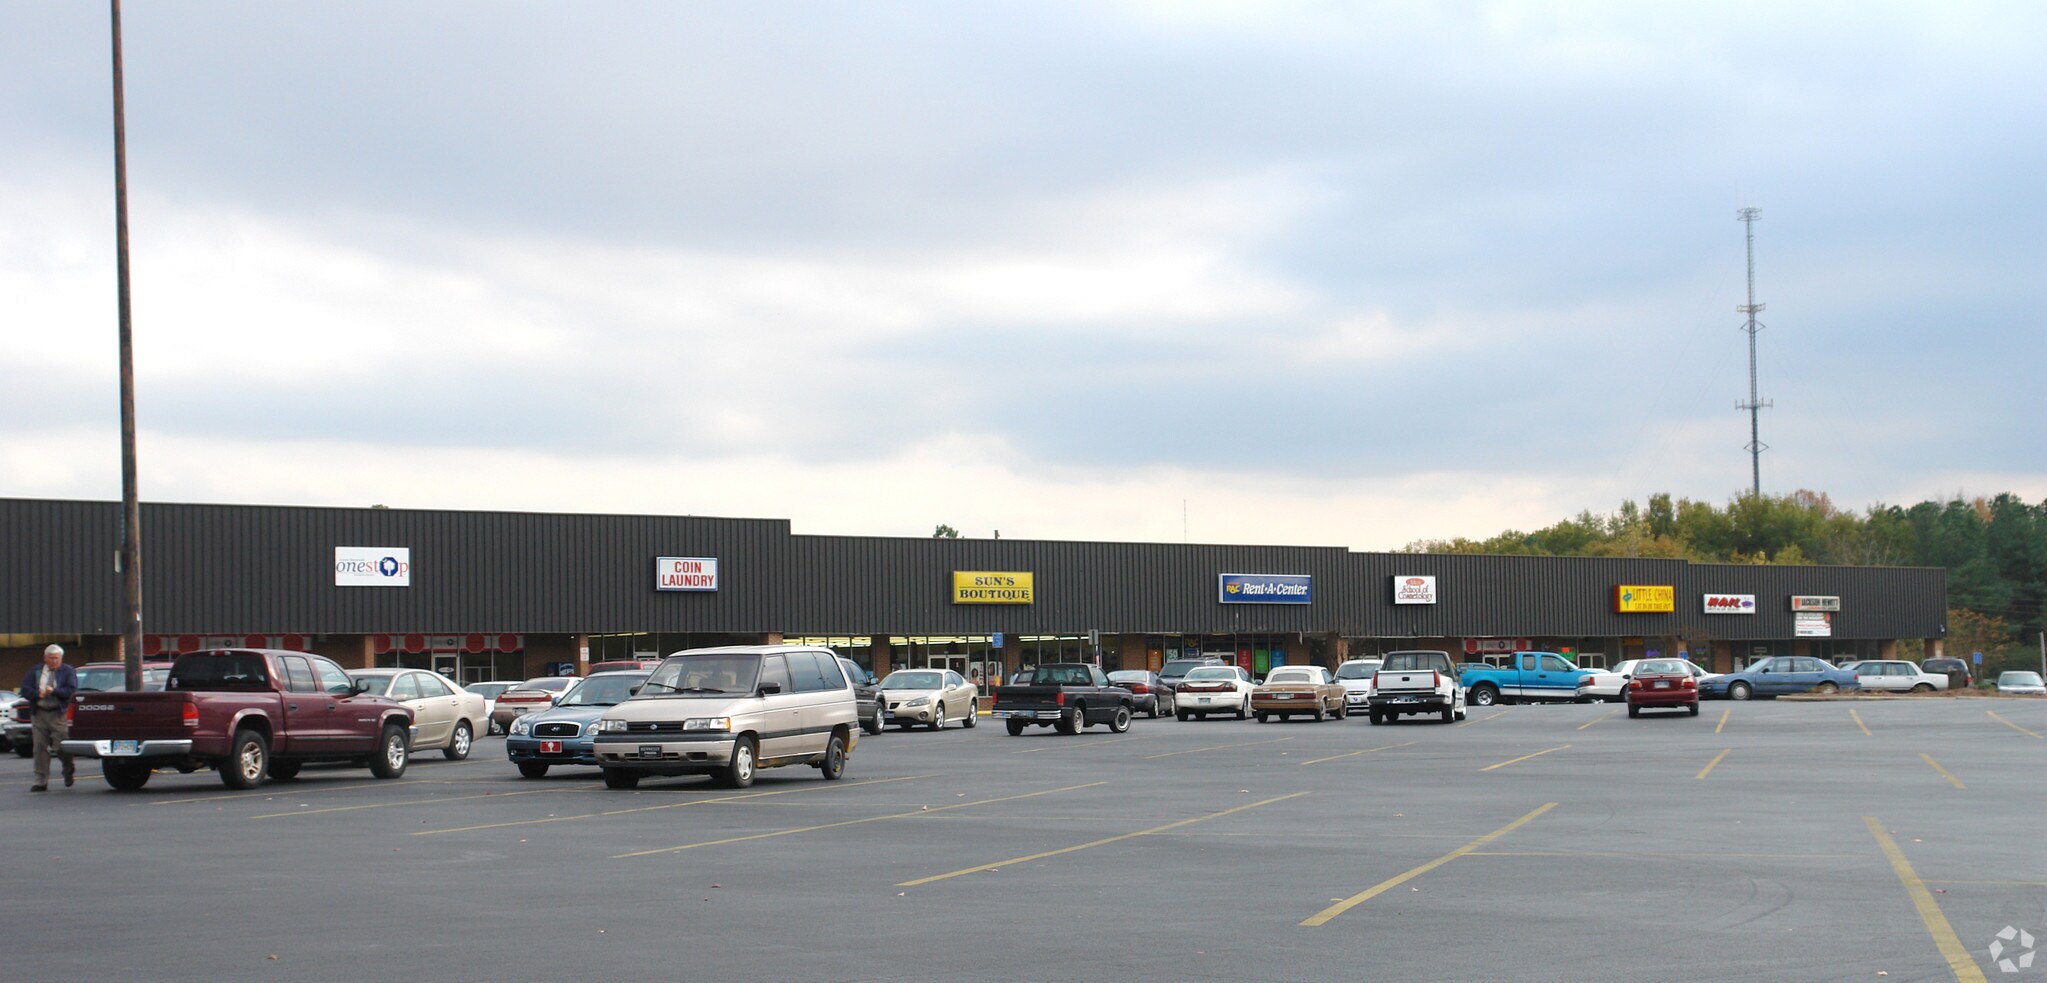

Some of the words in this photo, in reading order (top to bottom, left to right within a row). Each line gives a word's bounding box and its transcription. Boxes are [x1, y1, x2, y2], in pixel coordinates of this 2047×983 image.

[674, 561, 702, 573] COIN
[662, 574, 714, 587] LAUNDRY
[975, 576, 1015, 586] SUN'S
[959, 589, 1030, 600] BOUTIQUE
[1402, 585, 1421, 593] School
[1633, 588, 1652, 601] LITTLE
[1655, 588, 1672, 601] CHINA
[1801, 598, 1821, 606] JACKSON
[1822, 598, 1839, 607] HEWITT
